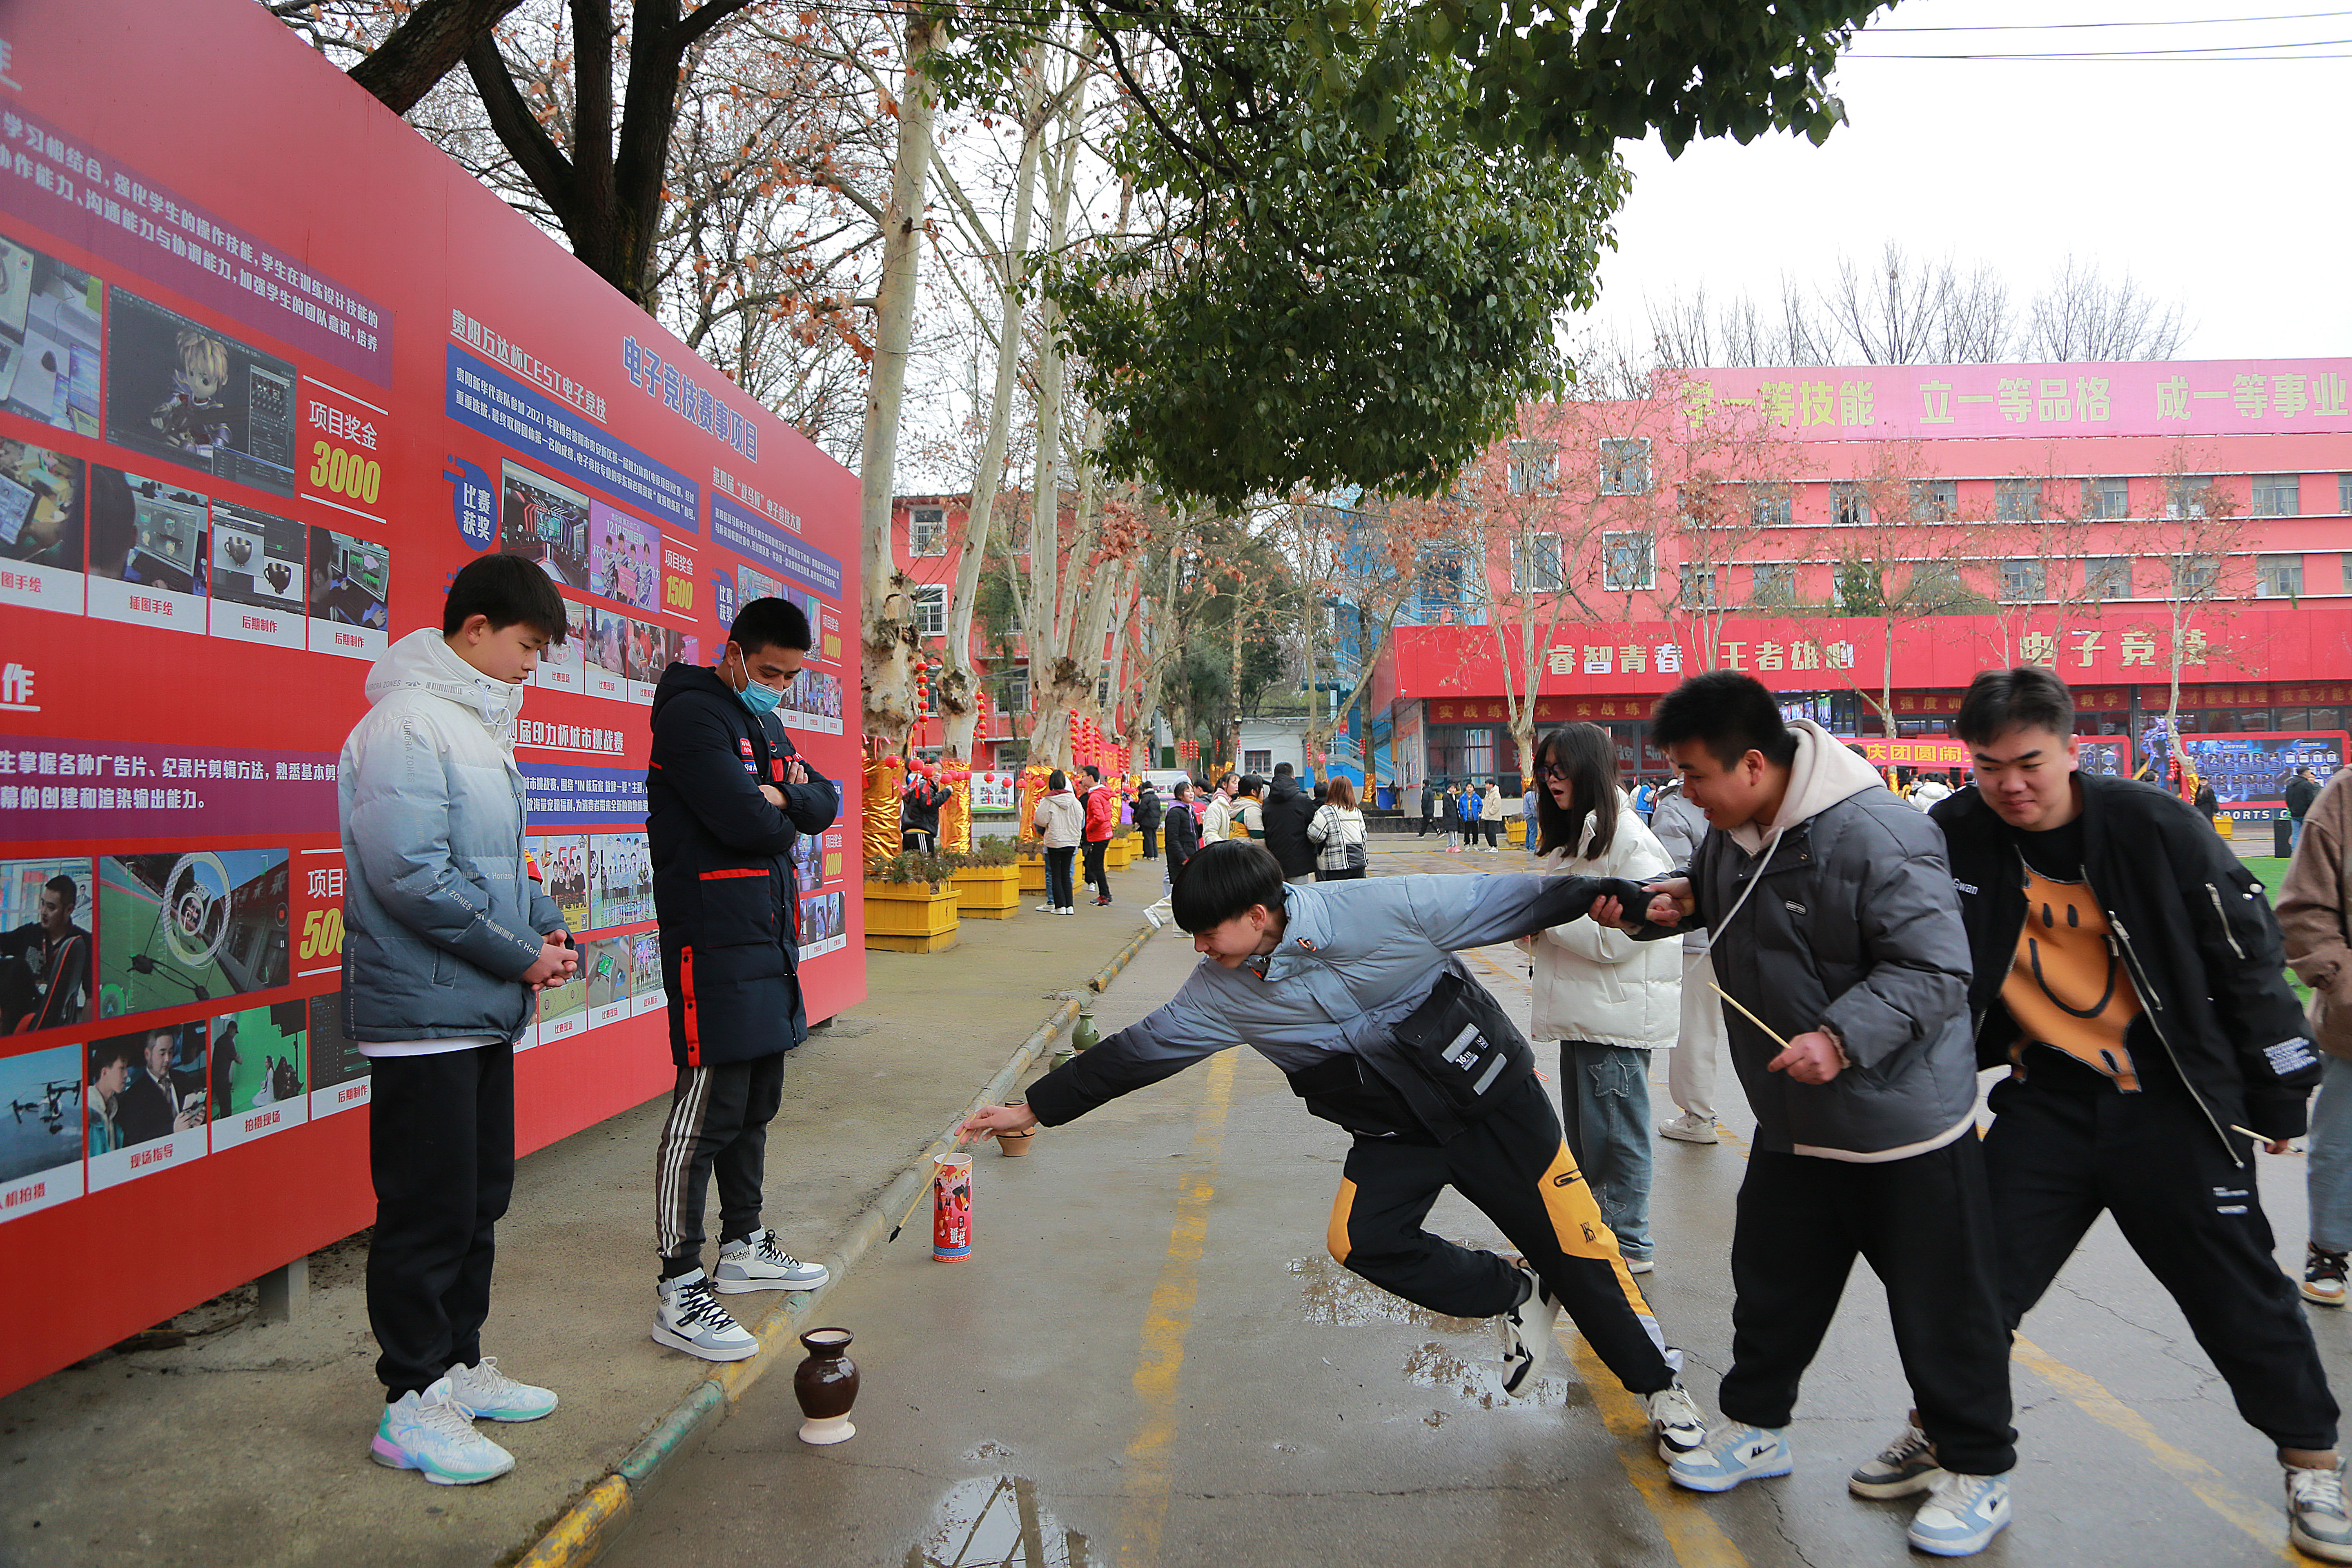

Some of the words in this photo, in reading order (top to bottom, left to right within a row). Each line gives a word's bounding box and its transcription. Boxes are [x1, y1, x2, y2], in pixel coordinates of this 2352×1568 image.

[452, 308, 607, 421] 贵阳万达杯CEST电子竞技
[623, 335, 758, 463] 电子竞技赛事项目
[1680, 381, 1875, 428] 学一等技能
[1919, 376, 2111, 425] 立一等品格
[2156, 372, 2349, 421] 成一等事业
[309, 399, 378, 451] 项目奖金
[310, 440, 381, 505] 3000
[463, 482, 490, 515] 比赛
[713, 466, 734, 493] 第四届
[767, 499, 802, 531] 电子竞技大赛
[463, 510, 490, 541] 获奖
[664, 549, 694, 576] 项目奖金
[1, 572, 42, 594] 图手绘
[666, 575, 693, 610] 1500
[719, 584, 733, 605] 比赛
[129, 595, 174, 617] 插图手绘
[719, 604, 733, 624] 获奖
[242, 615, 278, 634] 后期制作
[823, 614, 840, 633] 项目奖金
[335, 632, 365, 649] 后期制作
[824, 633, 842, 659] 10000
[2020, 629, 2207, 668] 电子竞技
[1547, 642, 1684, 676] 睿智青春
[1720, 639, 1855, 672] 王者雄心
[383, 679, 401, 688] ZONES
[1876, 696, 1962, 710] 强度训
[404, 719, 414, 752] AURORA
[1844, 742, 1973, 763] 庆团圆闹
[0, 750, 339, 782] 生掌握各种广告片、纪录片剪辑方法，熟悉基本剪
[406, 755, 415, 783] ZONES
[1, 786, 205, 809] 幕的创建和渲染输出能力。
[2217, 809, 2270, 820] PORTS
[825, 833, 843, 849] 项目奖金
[826, 852, 843, 877] 8000
[308, 868, 347, 898] 项目
[448, 889, 473, 911] ZONES
[338, 1084, 368, 1104] 后期制作
[245, 1109, 281, 1133] 拍摄现场
[130, 1144, 174, 1170] 现场指导
[0, 1182, 46, 1210] 机拍摄
